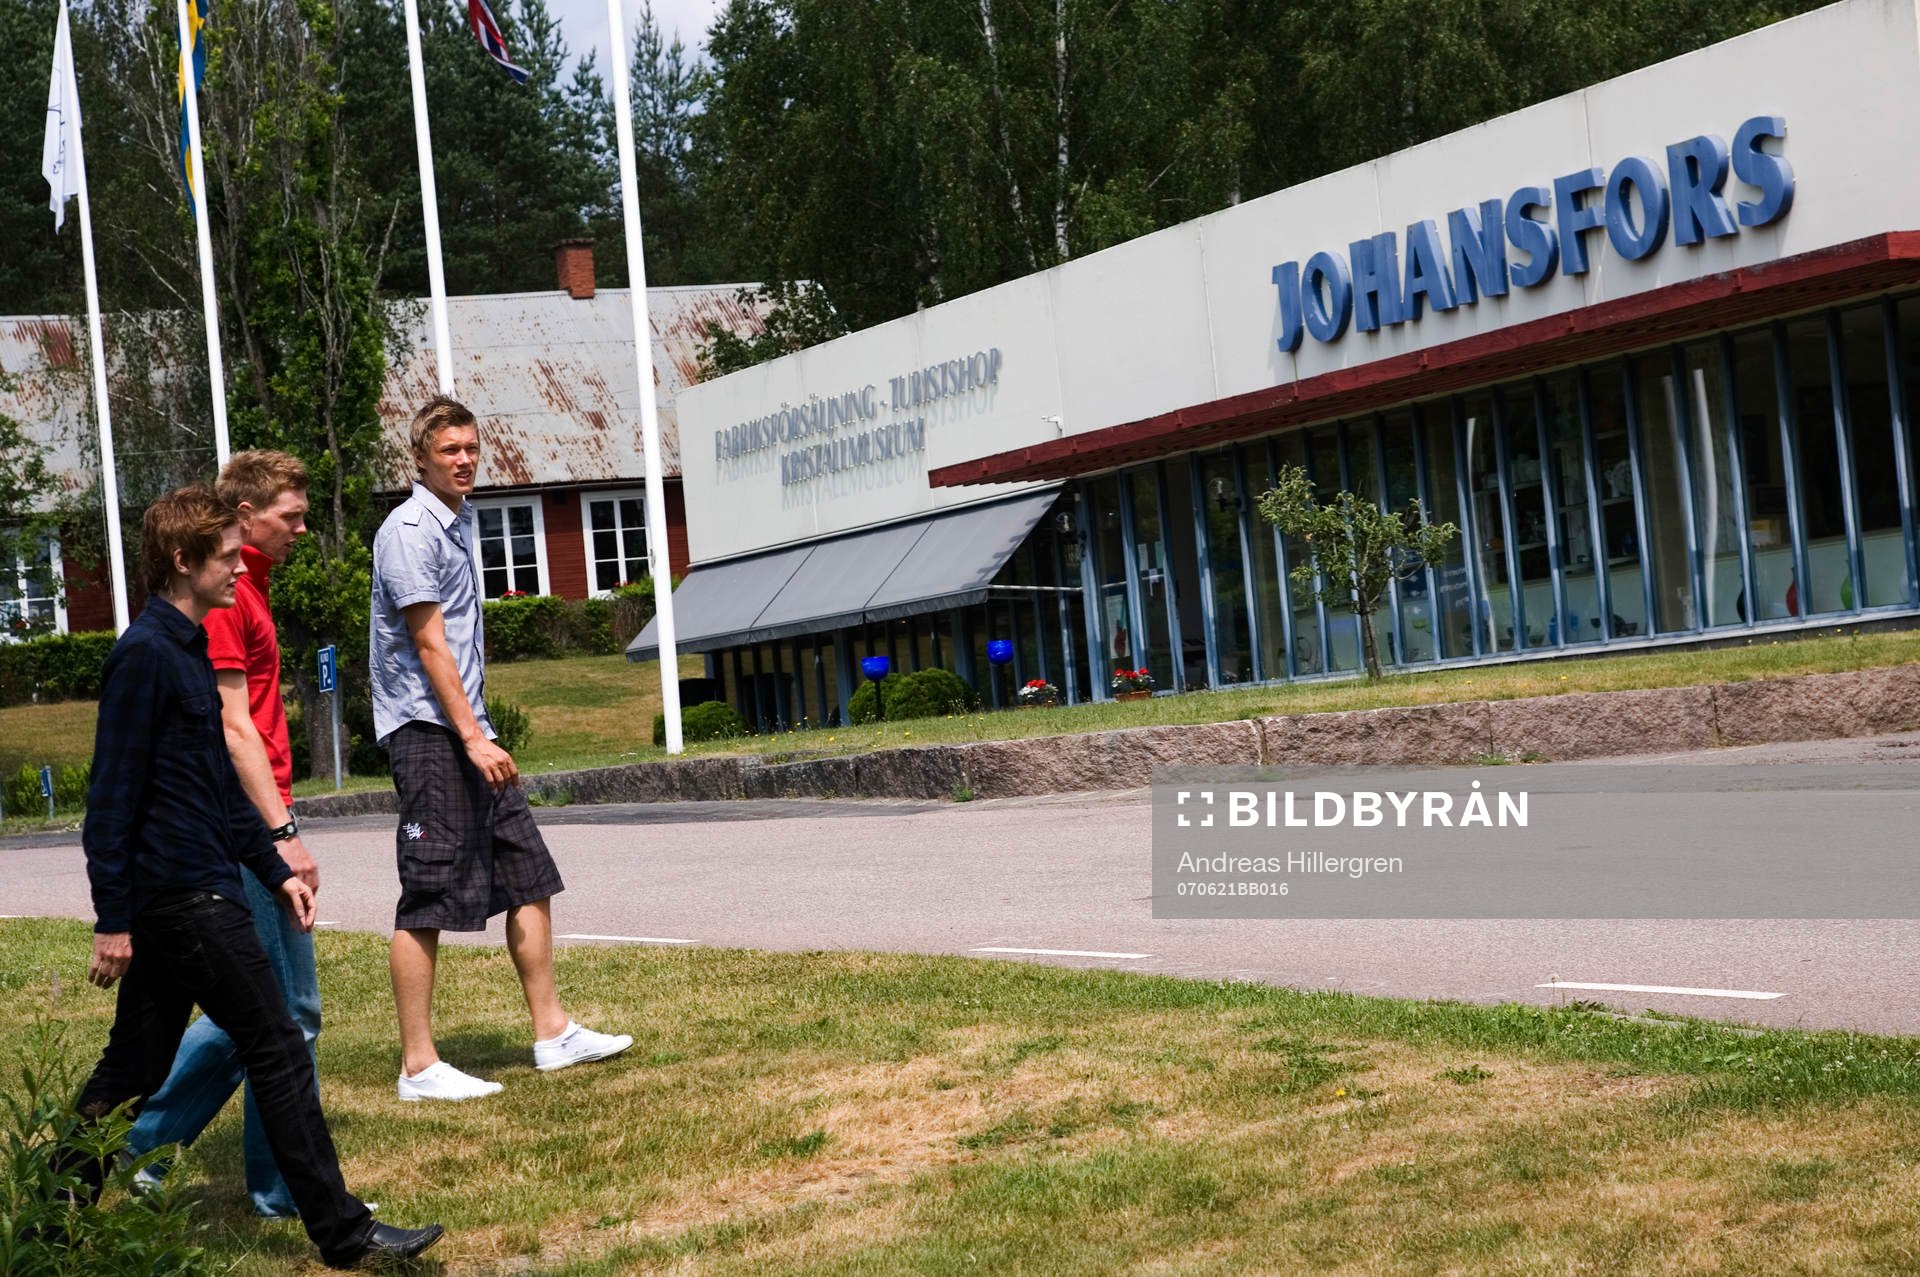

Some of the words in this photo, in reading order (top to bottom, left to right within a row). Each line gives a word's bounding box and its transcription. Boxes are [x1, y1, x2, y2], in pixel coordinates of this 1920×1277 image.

[1272, 116, 1795, 353] JOHANSFORS
[889, 347, 1002, 413] TURISTSHOP
[781, 416, 925, 486] KRISTALLMUSEUM
